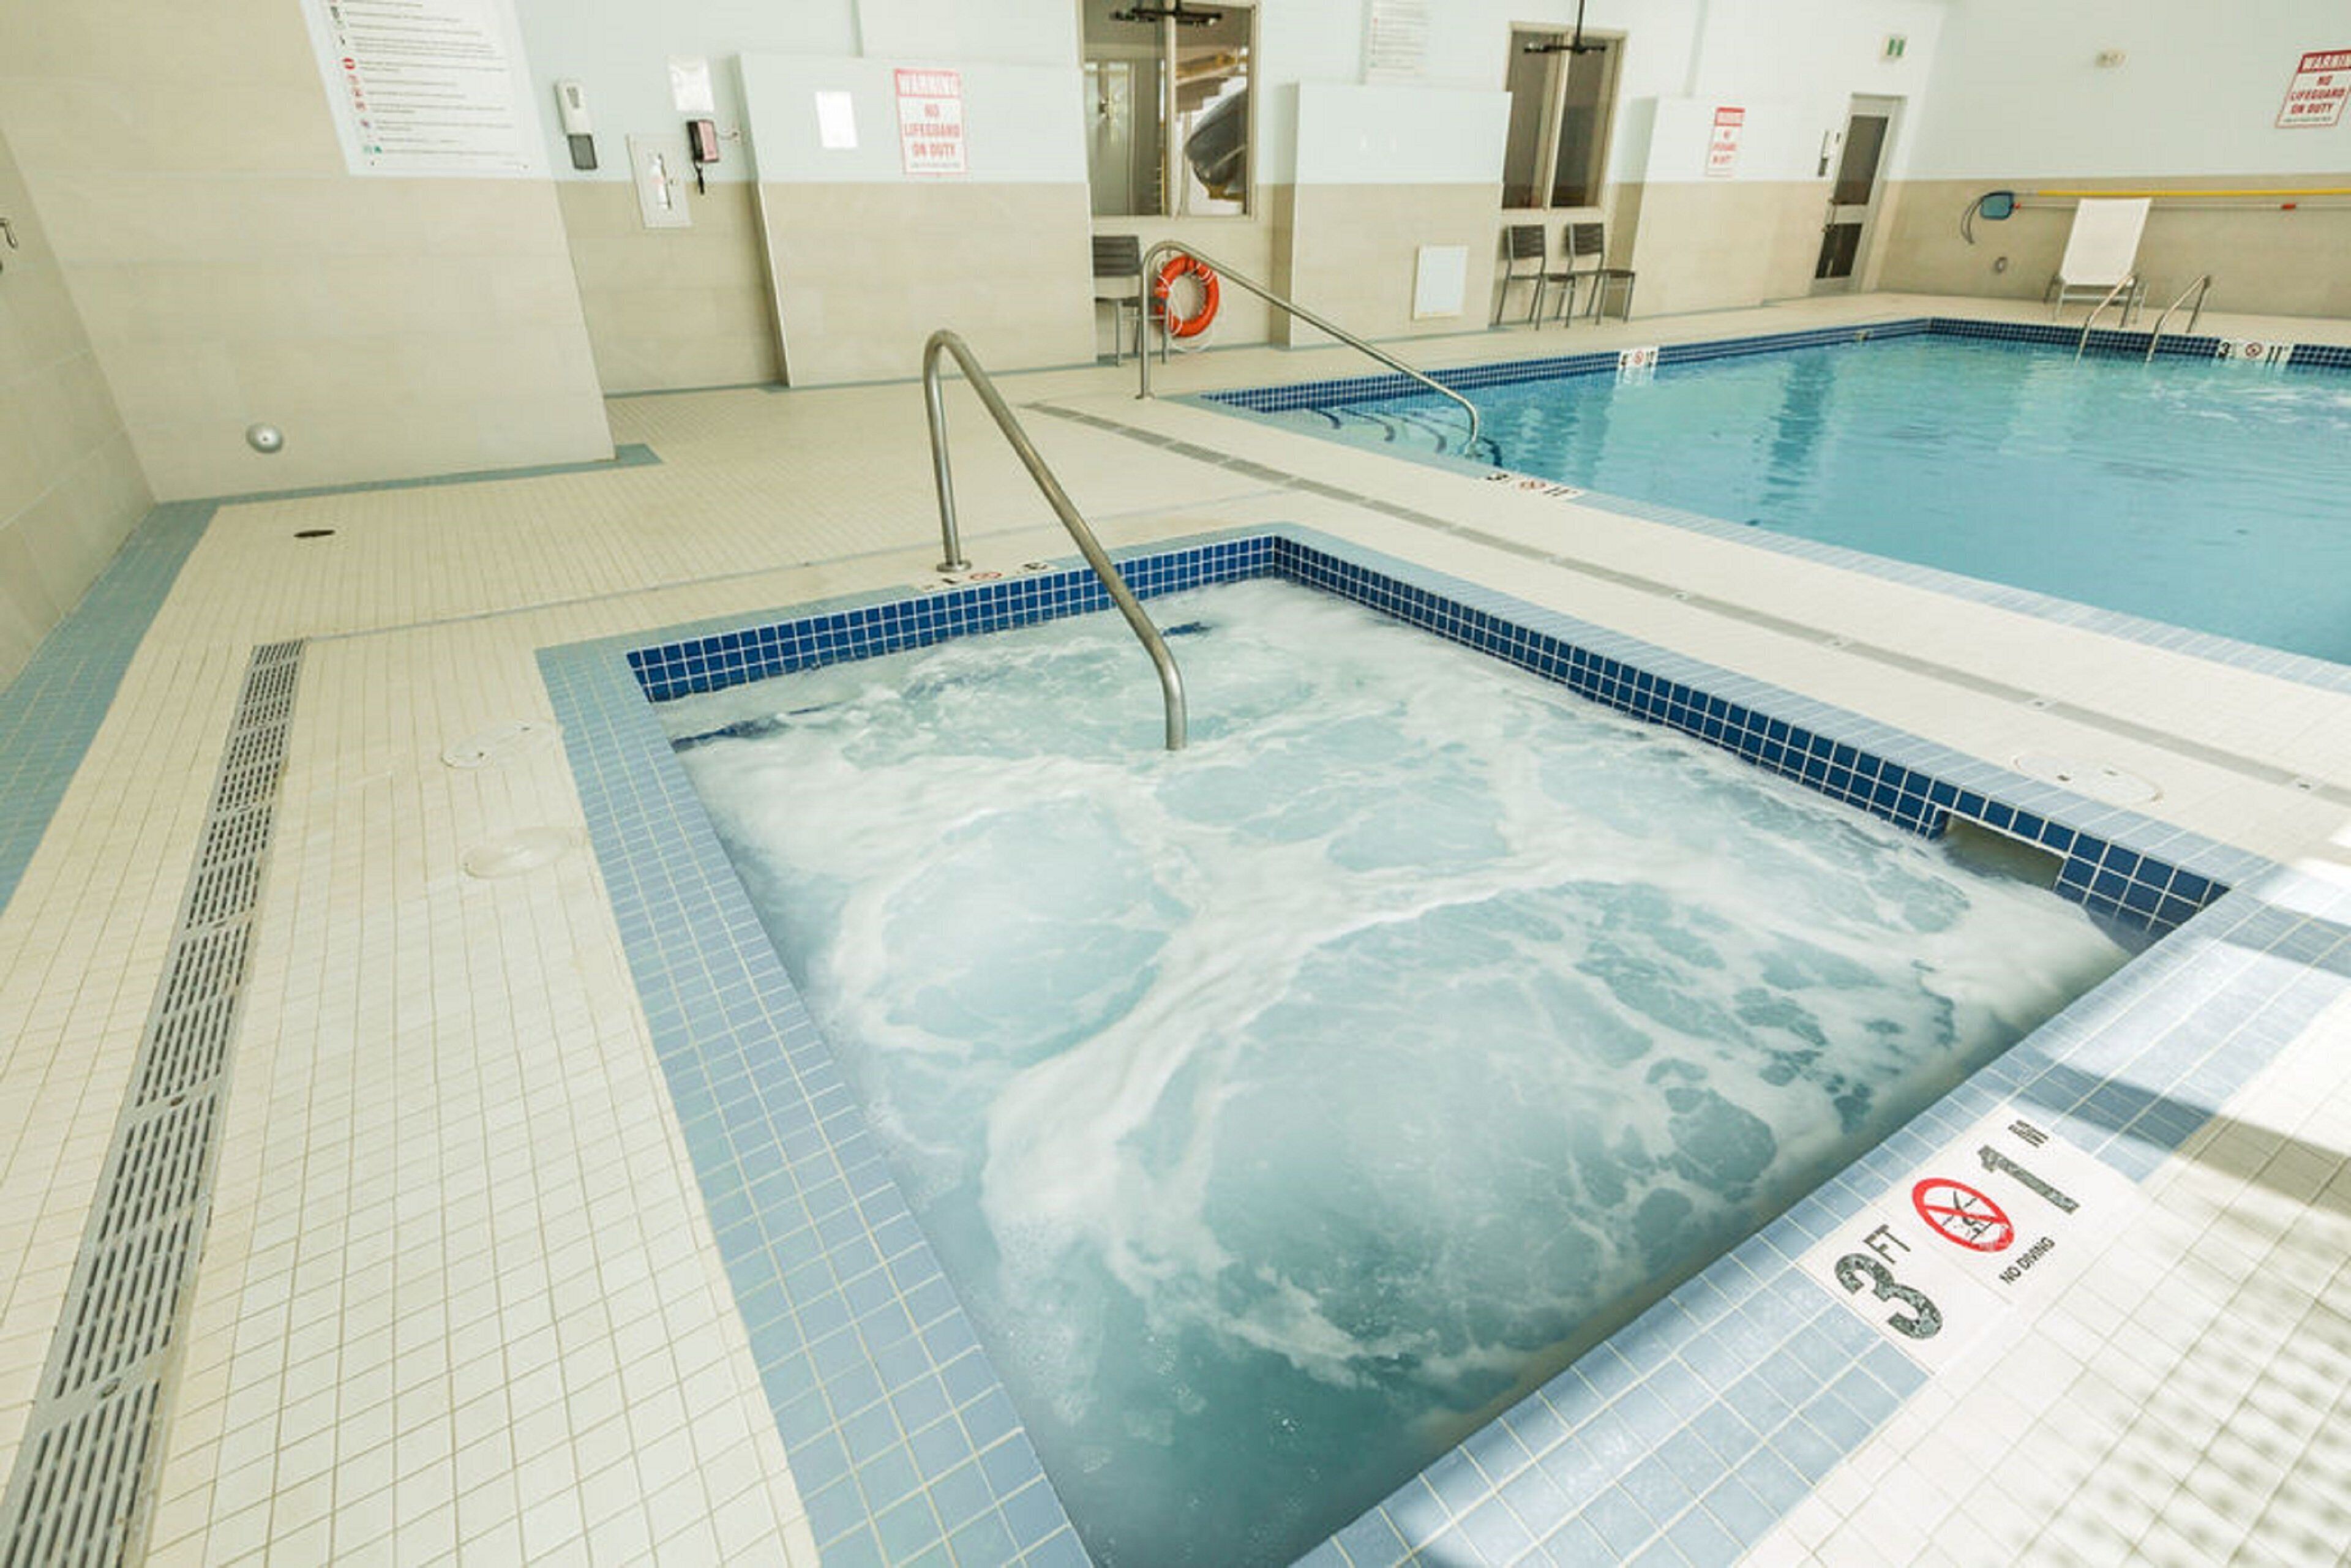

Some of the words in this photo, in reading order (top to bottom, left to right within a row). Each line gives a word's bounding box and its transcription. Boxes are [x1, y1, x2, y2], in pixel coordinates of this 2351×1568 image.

[2317, 75, 2333, 86] NO
[2291, 88, 2345, 100] LIFEGUARD
[924, 103, 940, 118] NO
[2292, 103, 2304, 114] ON
[2307, 103, 2333, 114] DUTY
[904, 122, 961, 138] LIFEGUARD
[913, 141, 926, 157] ON
[929, 142, 956, 157] DUTY
[1978, 1144, 2080, 1215] 1
[1863, 1225, 1911, 1264] FT
[1998, 1266, 2021, 1285] NO
[2016, 1236, 2055, 1270] DIVING
[1835, 1253, 1943, 1340] 3
